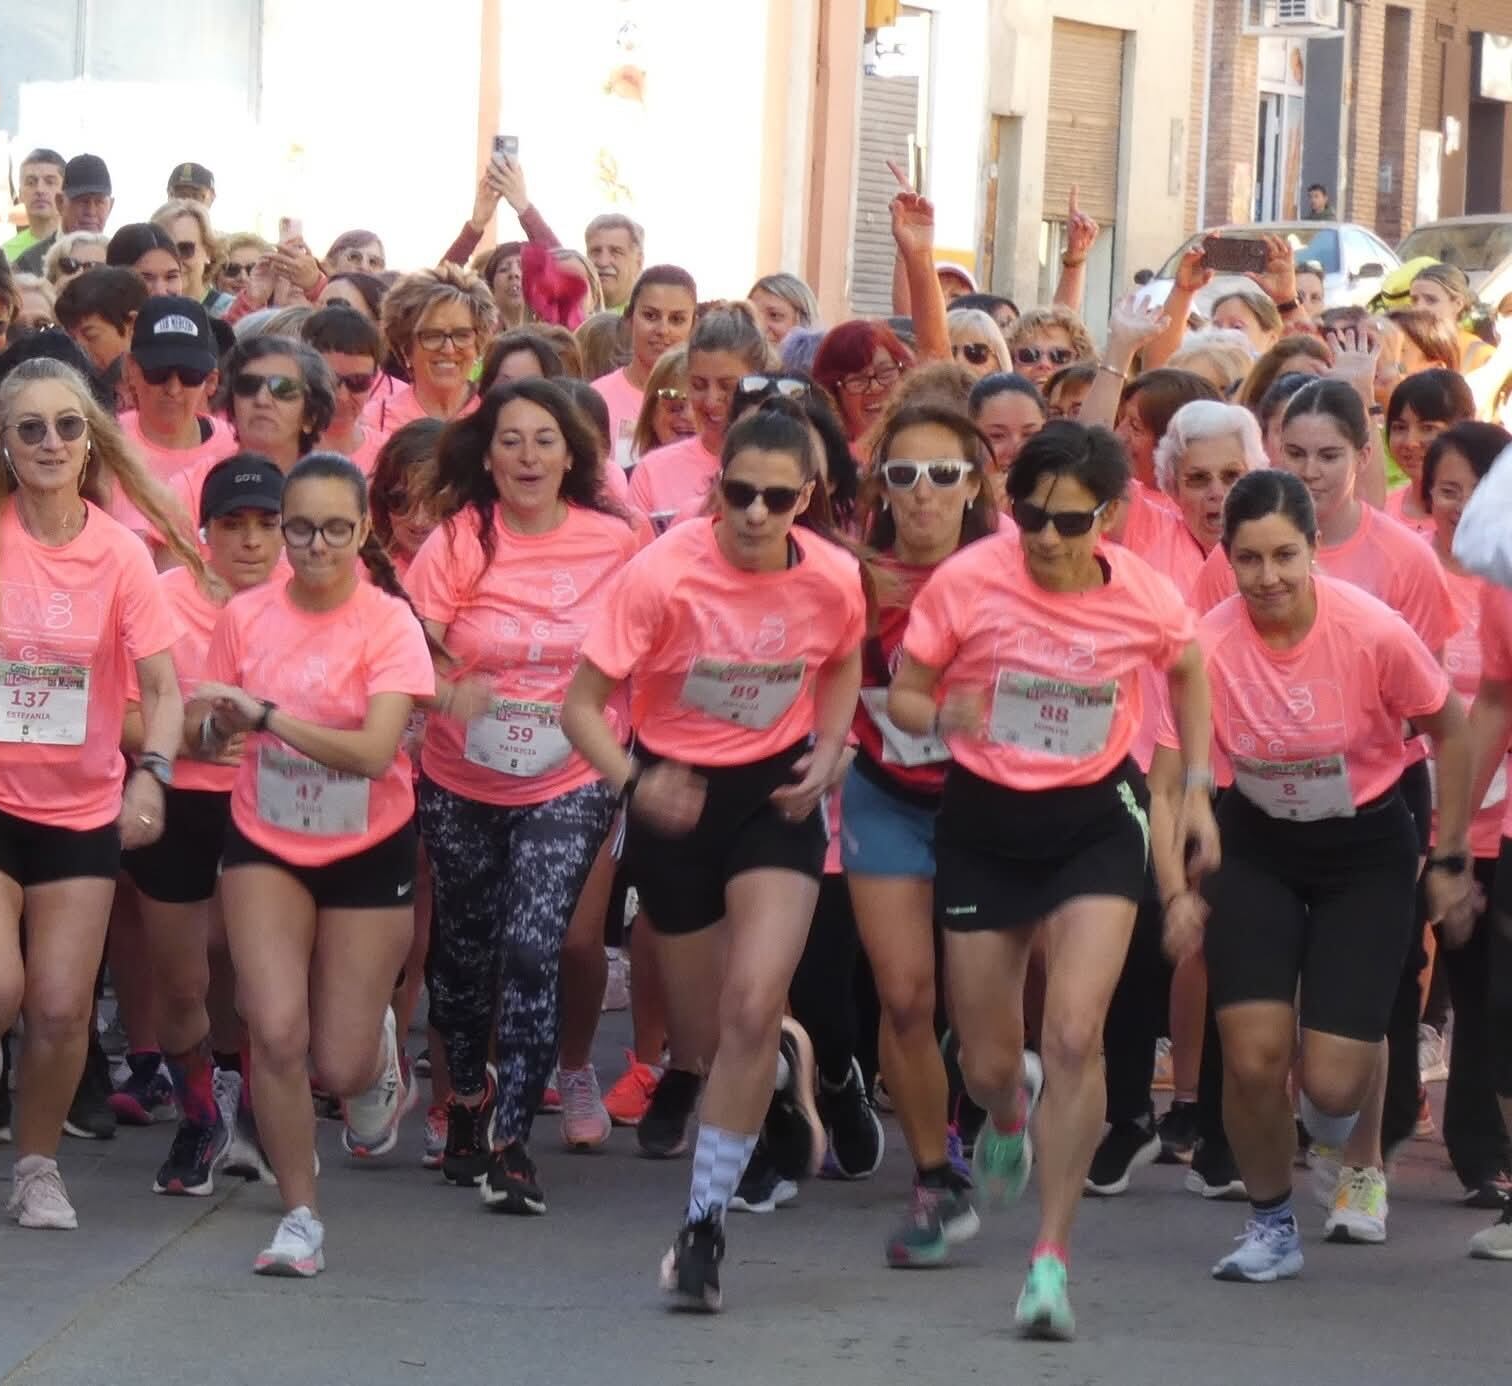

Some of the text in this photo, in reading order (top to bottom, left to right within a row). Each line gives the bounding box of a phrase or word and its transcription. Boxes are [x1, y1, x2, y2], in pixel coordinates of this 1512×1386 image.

[10, 689, 50, 708] 137
[507, 725, 534, 742] 59
[1282, 783, 1296, 795] 8
